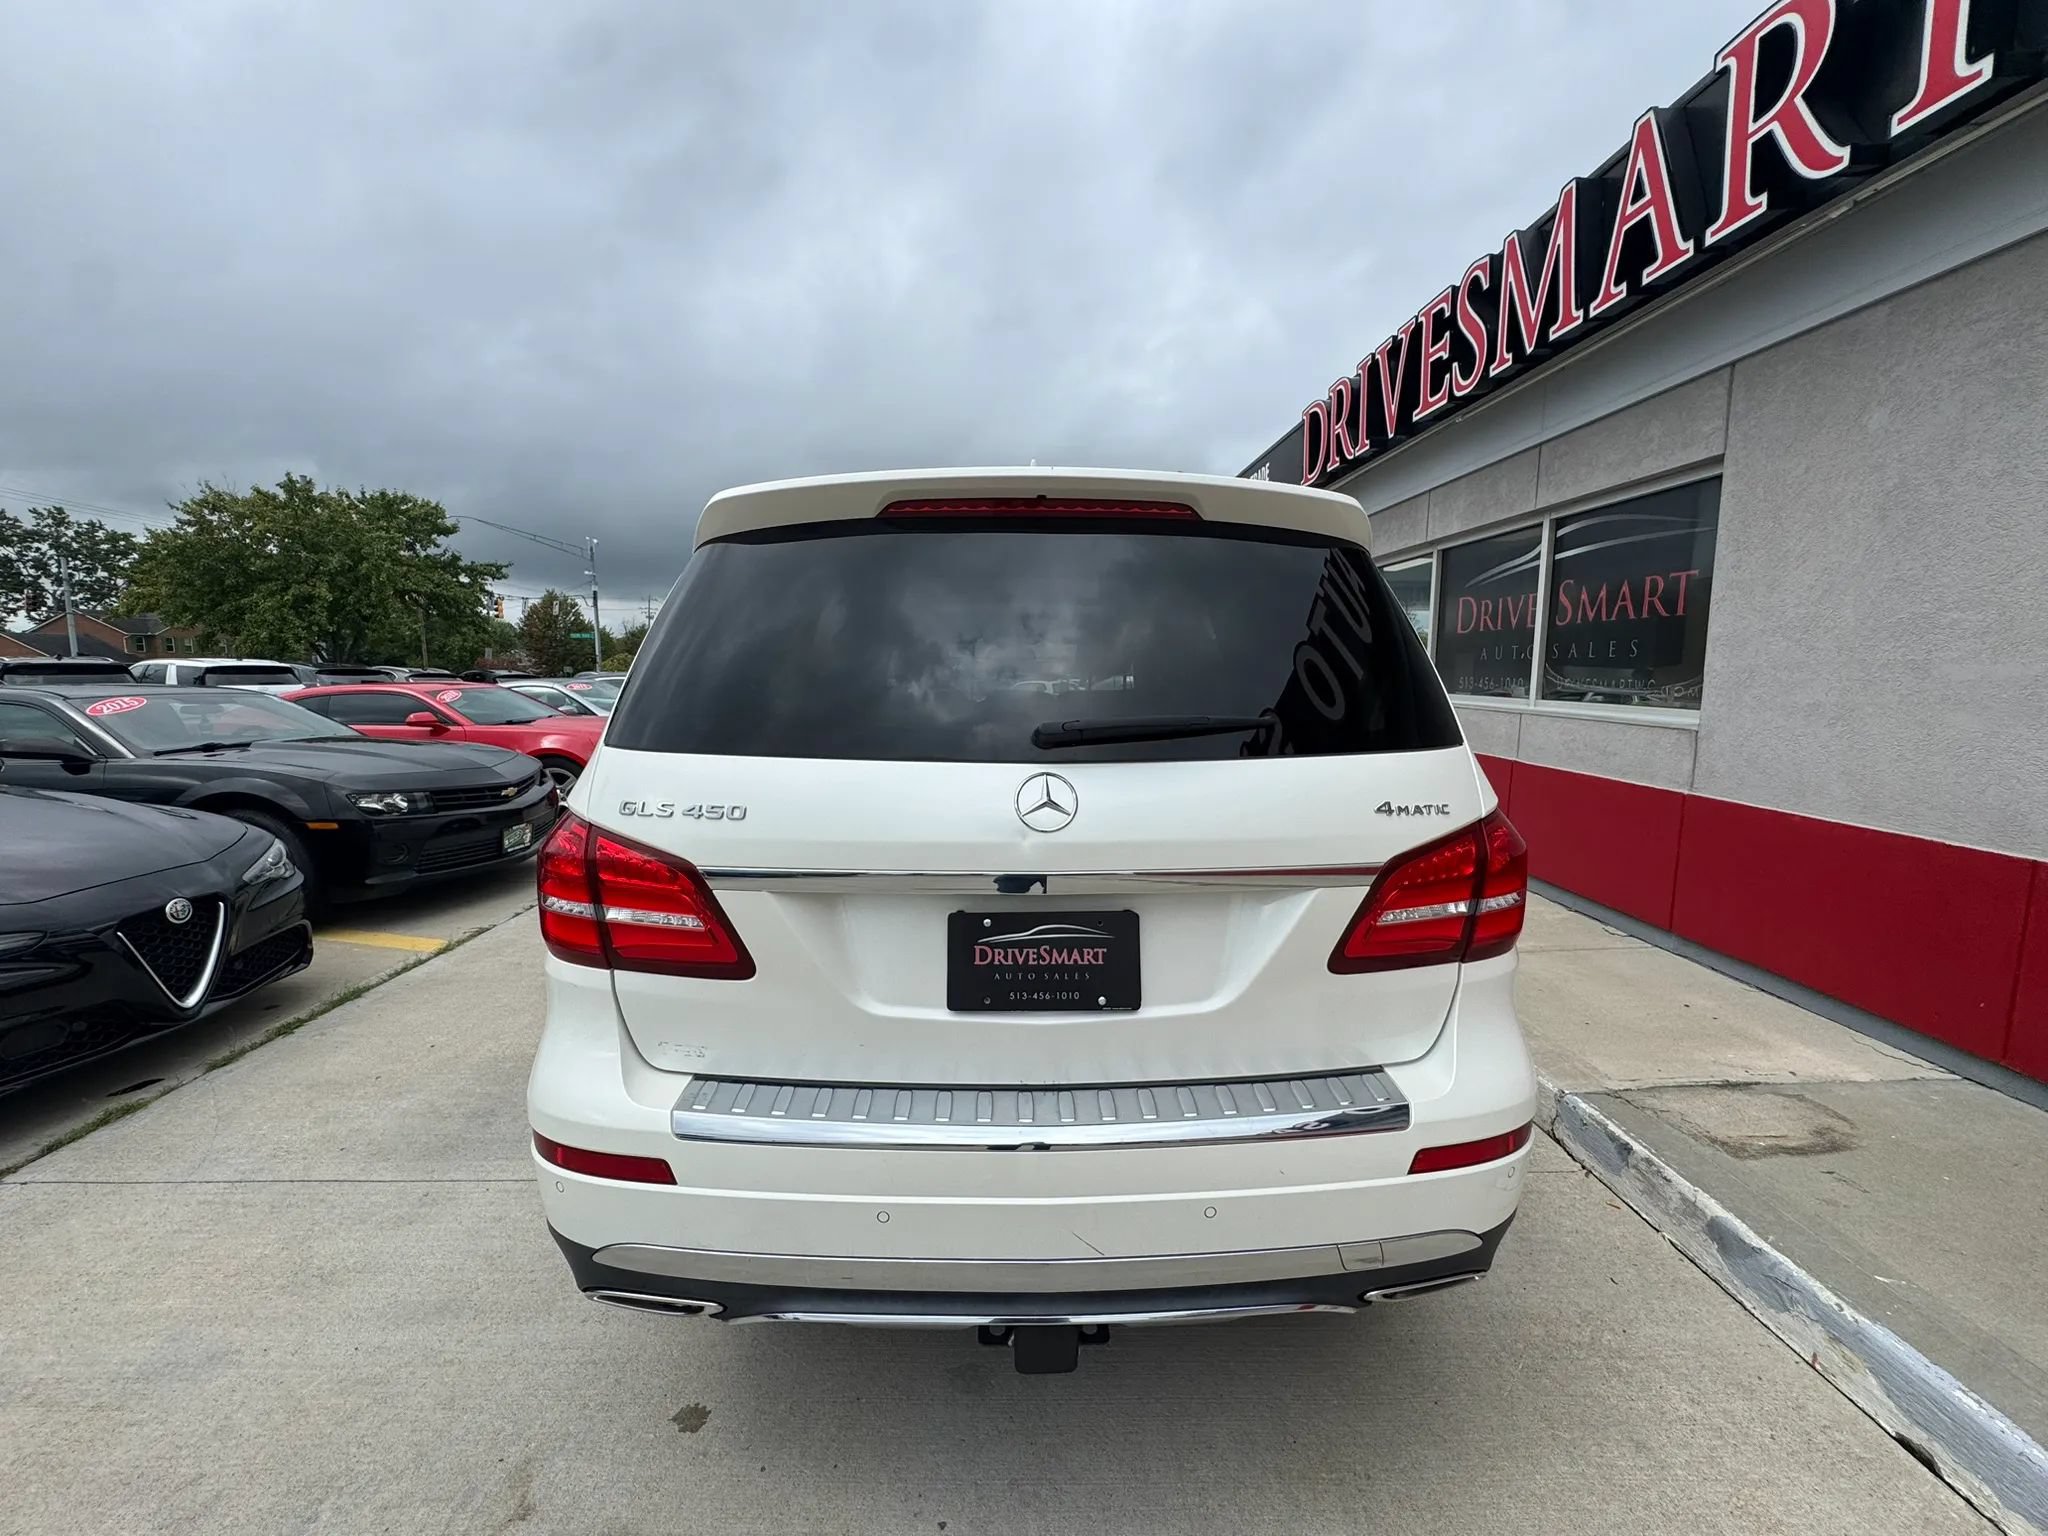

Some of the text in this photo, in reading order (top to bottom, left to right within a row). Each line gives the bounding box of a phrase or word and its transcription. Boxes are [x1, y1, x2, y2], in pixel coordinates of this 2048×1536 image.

[1551, 639, 1639, 659] SALES
[95, 698, 139, 713] 2015
[618, 799, 748, 821] GLS 450
[1374, 801, 1451, 817] 4MATIC
[993, 972, 1091, 981] AUTO SALES
[1009, 991, 1080, 1000] 513-456-1010
